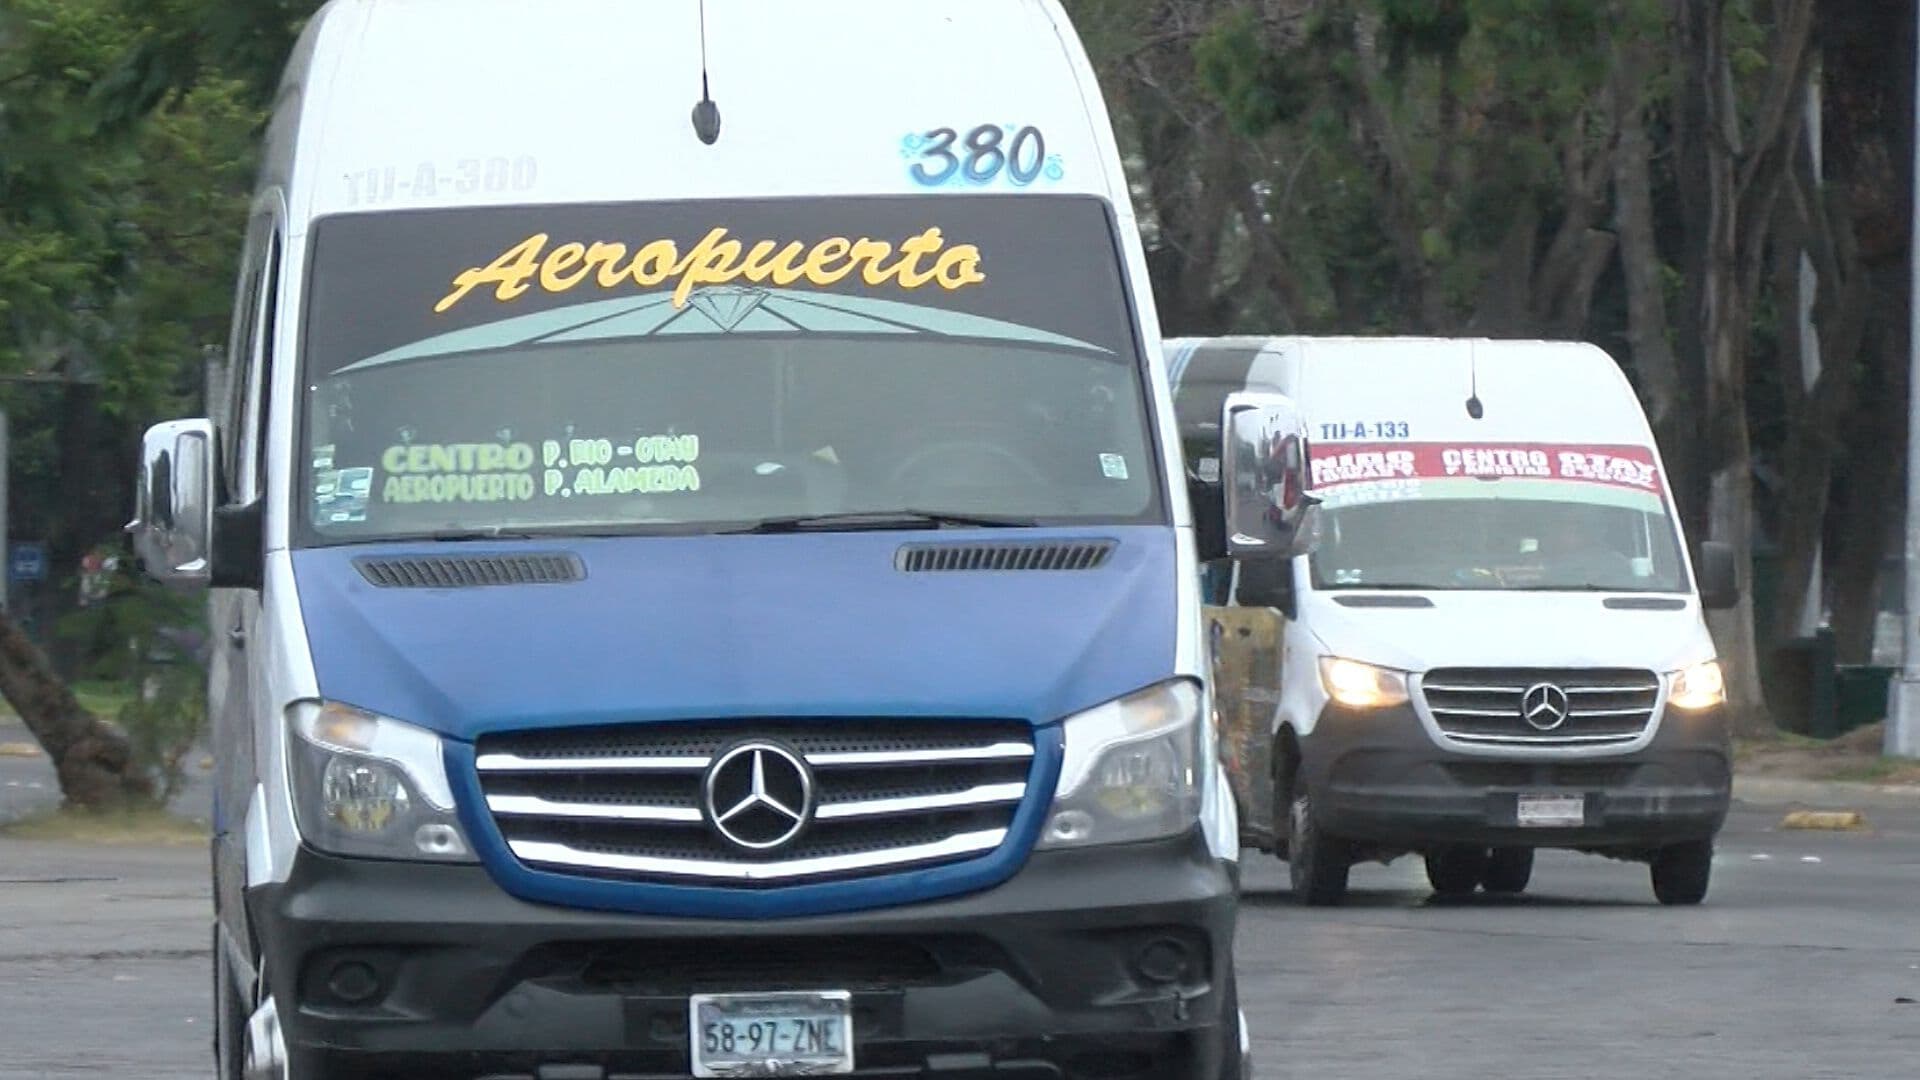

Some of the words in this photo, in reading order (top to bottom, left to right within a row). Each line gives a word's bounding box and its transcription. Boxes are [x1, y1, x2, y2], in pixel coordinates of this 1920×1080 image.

[910, 123, 1046, 187] 380
[433, 225, 987, 313] Aeropuerto
[1319, 421, 1410, 440] TIJ-A-133
[382, 443, 534, 473] CENTRO
[383, 474, 534, 502] AEROPUERTO
[704, 1019, 840, 1054] 58-97-ZNE
